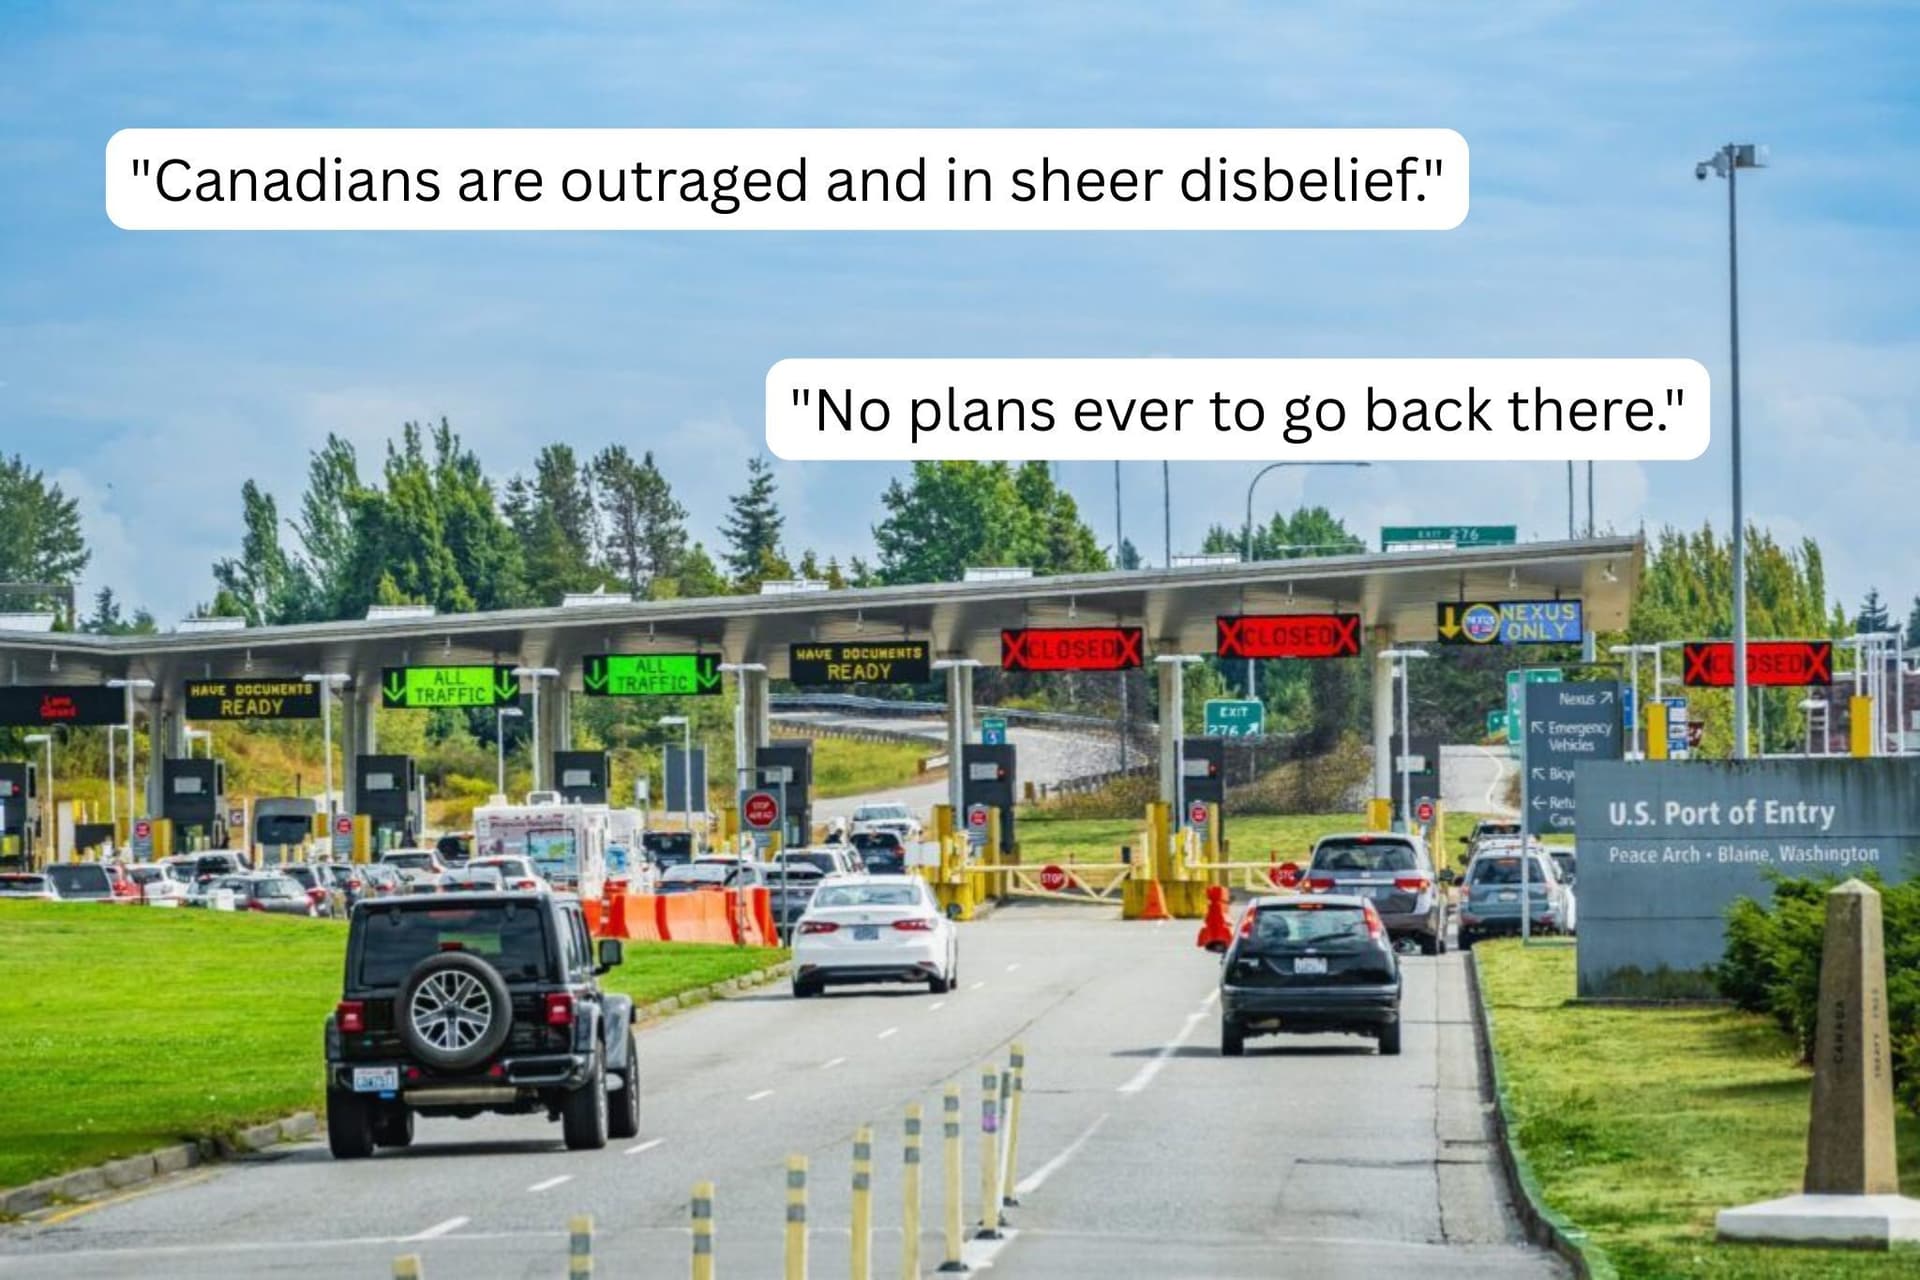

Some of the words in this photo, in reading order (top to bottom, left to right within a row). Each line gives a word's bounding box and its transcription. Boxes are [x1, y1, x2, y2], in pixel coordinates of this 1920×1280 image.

[1450, 527, 1479, 541] 276
[1501, 604, 1575, 621] NEXUS
[1243, 626, 1335, 646] CLOSED
[1507, 623, 1568, 640] ONLY
[796, 647, 832, 661] HAVE
[843, 646, 922, 660] DOCUMENTS
[1026, 639, 1118, 659] CLOSED
[635, 659, 666, 674] ALL
[1713, 653, 1801, 674] COSED
[433, 671, 465, 686] ALL
[827, 663, 891, 681] READY
[191, 684, 226, 697] HAVE
[235, 683, 313, 697] DOCUMENTS
[617, 675, 688, 691] TRAFFIC
[415, 686, 486, 703] TRAFFIC
[1559, 692, 1596, 706] Nexus
[221, 699, 284, 716] READY
[1219, 707, 1248, 718] EXIT
[1208, 725, 1239, 737] 276
[1549, 721, 1613, 737] Emergency
[1549, 738, 1595, 752] Vehicles
[1549, 768, 1575, 784] Bicy
[1549, 796, 1576, 809] Retu
[1609, 801, 1657, 827] U.S.
[1665, 801, 1721, 827] Port
[1728, 798, 1758, 826] of
[1765, 800, 1836, 831] Entry
[1609, 847, 1658, 864] Peace
[1662, 846, 1701, 864] Arch
[1717, 845, 1775, 865] Blaine,
[1779, 845, 1880, 867] Washington
[1042, 873, 1063, 884] STOP
